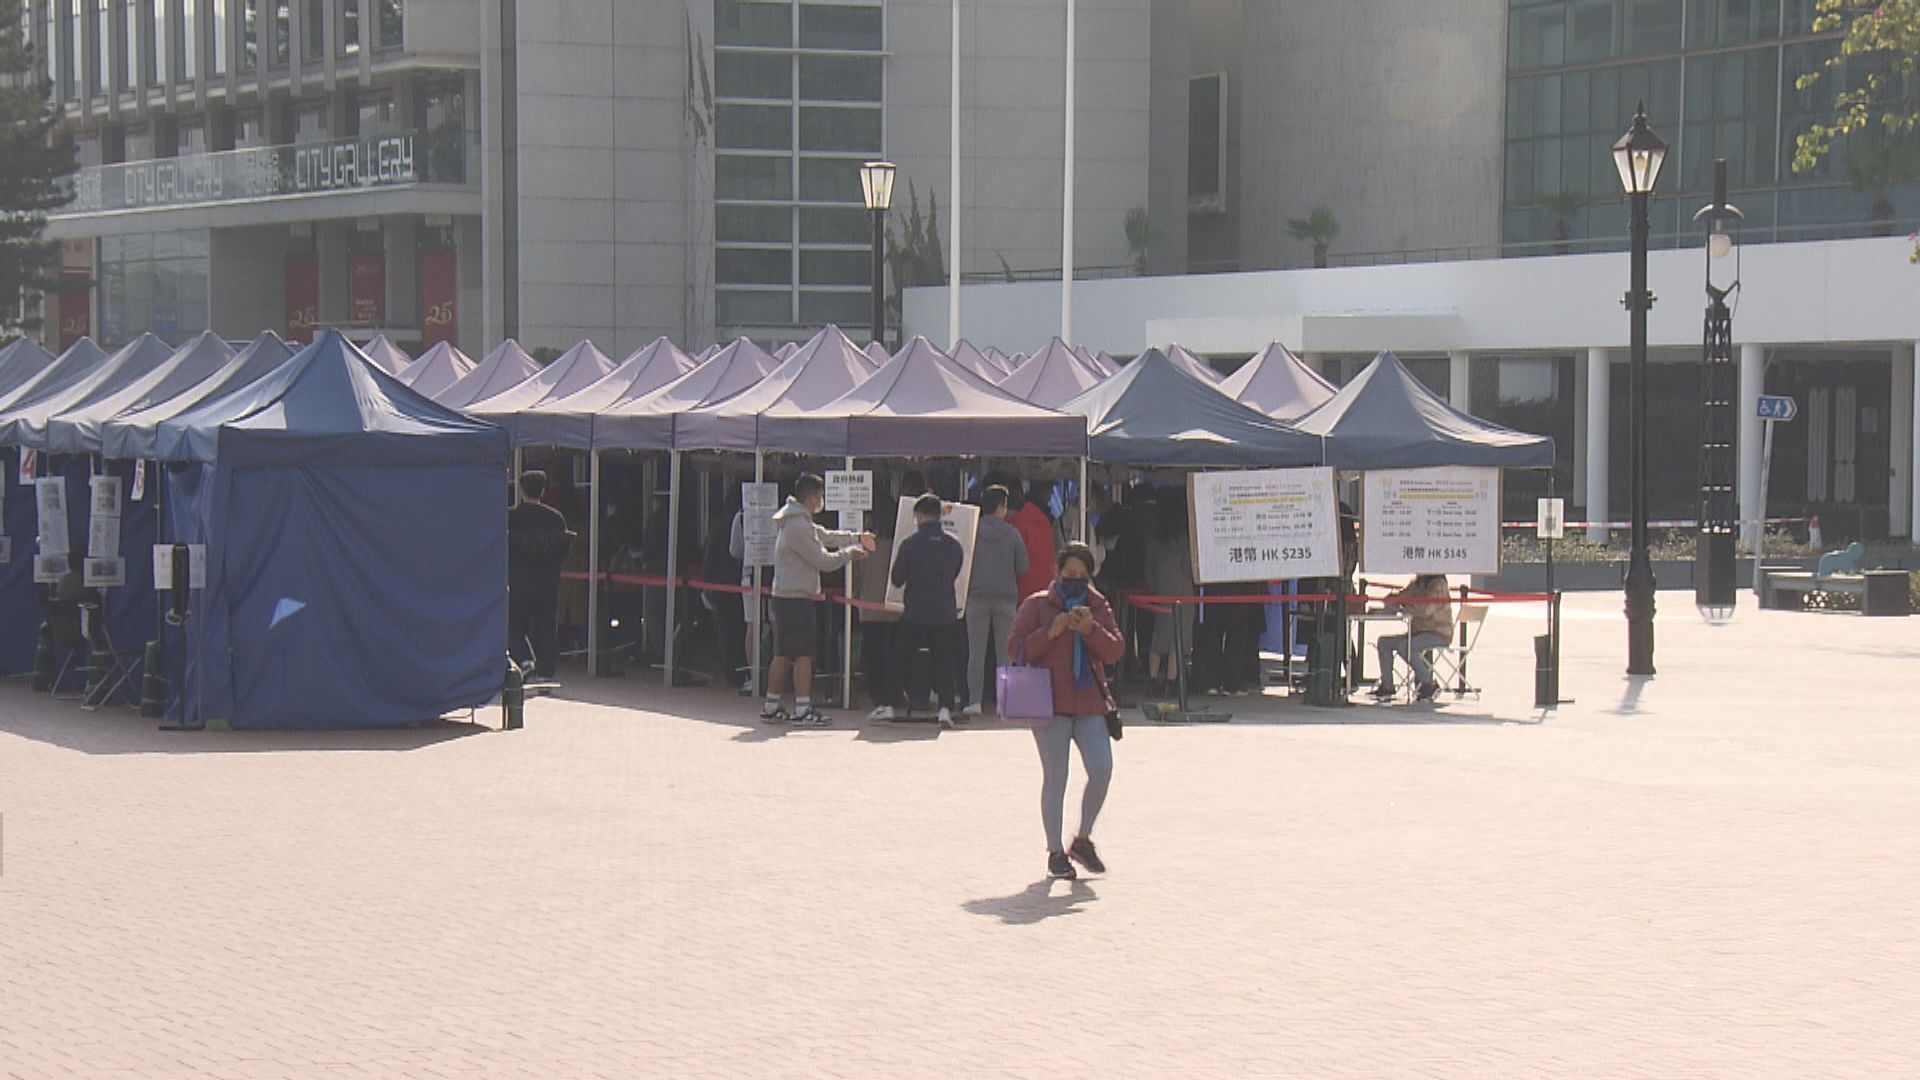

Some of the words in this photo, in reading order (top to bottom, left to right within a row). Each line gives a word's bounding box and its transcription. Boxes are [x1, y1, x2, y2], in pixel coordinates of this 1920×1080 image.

[425, 302, 453, 325] 25
[1229, 547, 1257, 563] 港幣
[1262, 548, 1279, 561] HK
[1282, 546, 1312, 561] $235
[1402, 546, 1425, 559] 港幣
[1428, 549, 1442, 559] HK
[1444, 547, 1467, 559] $145
